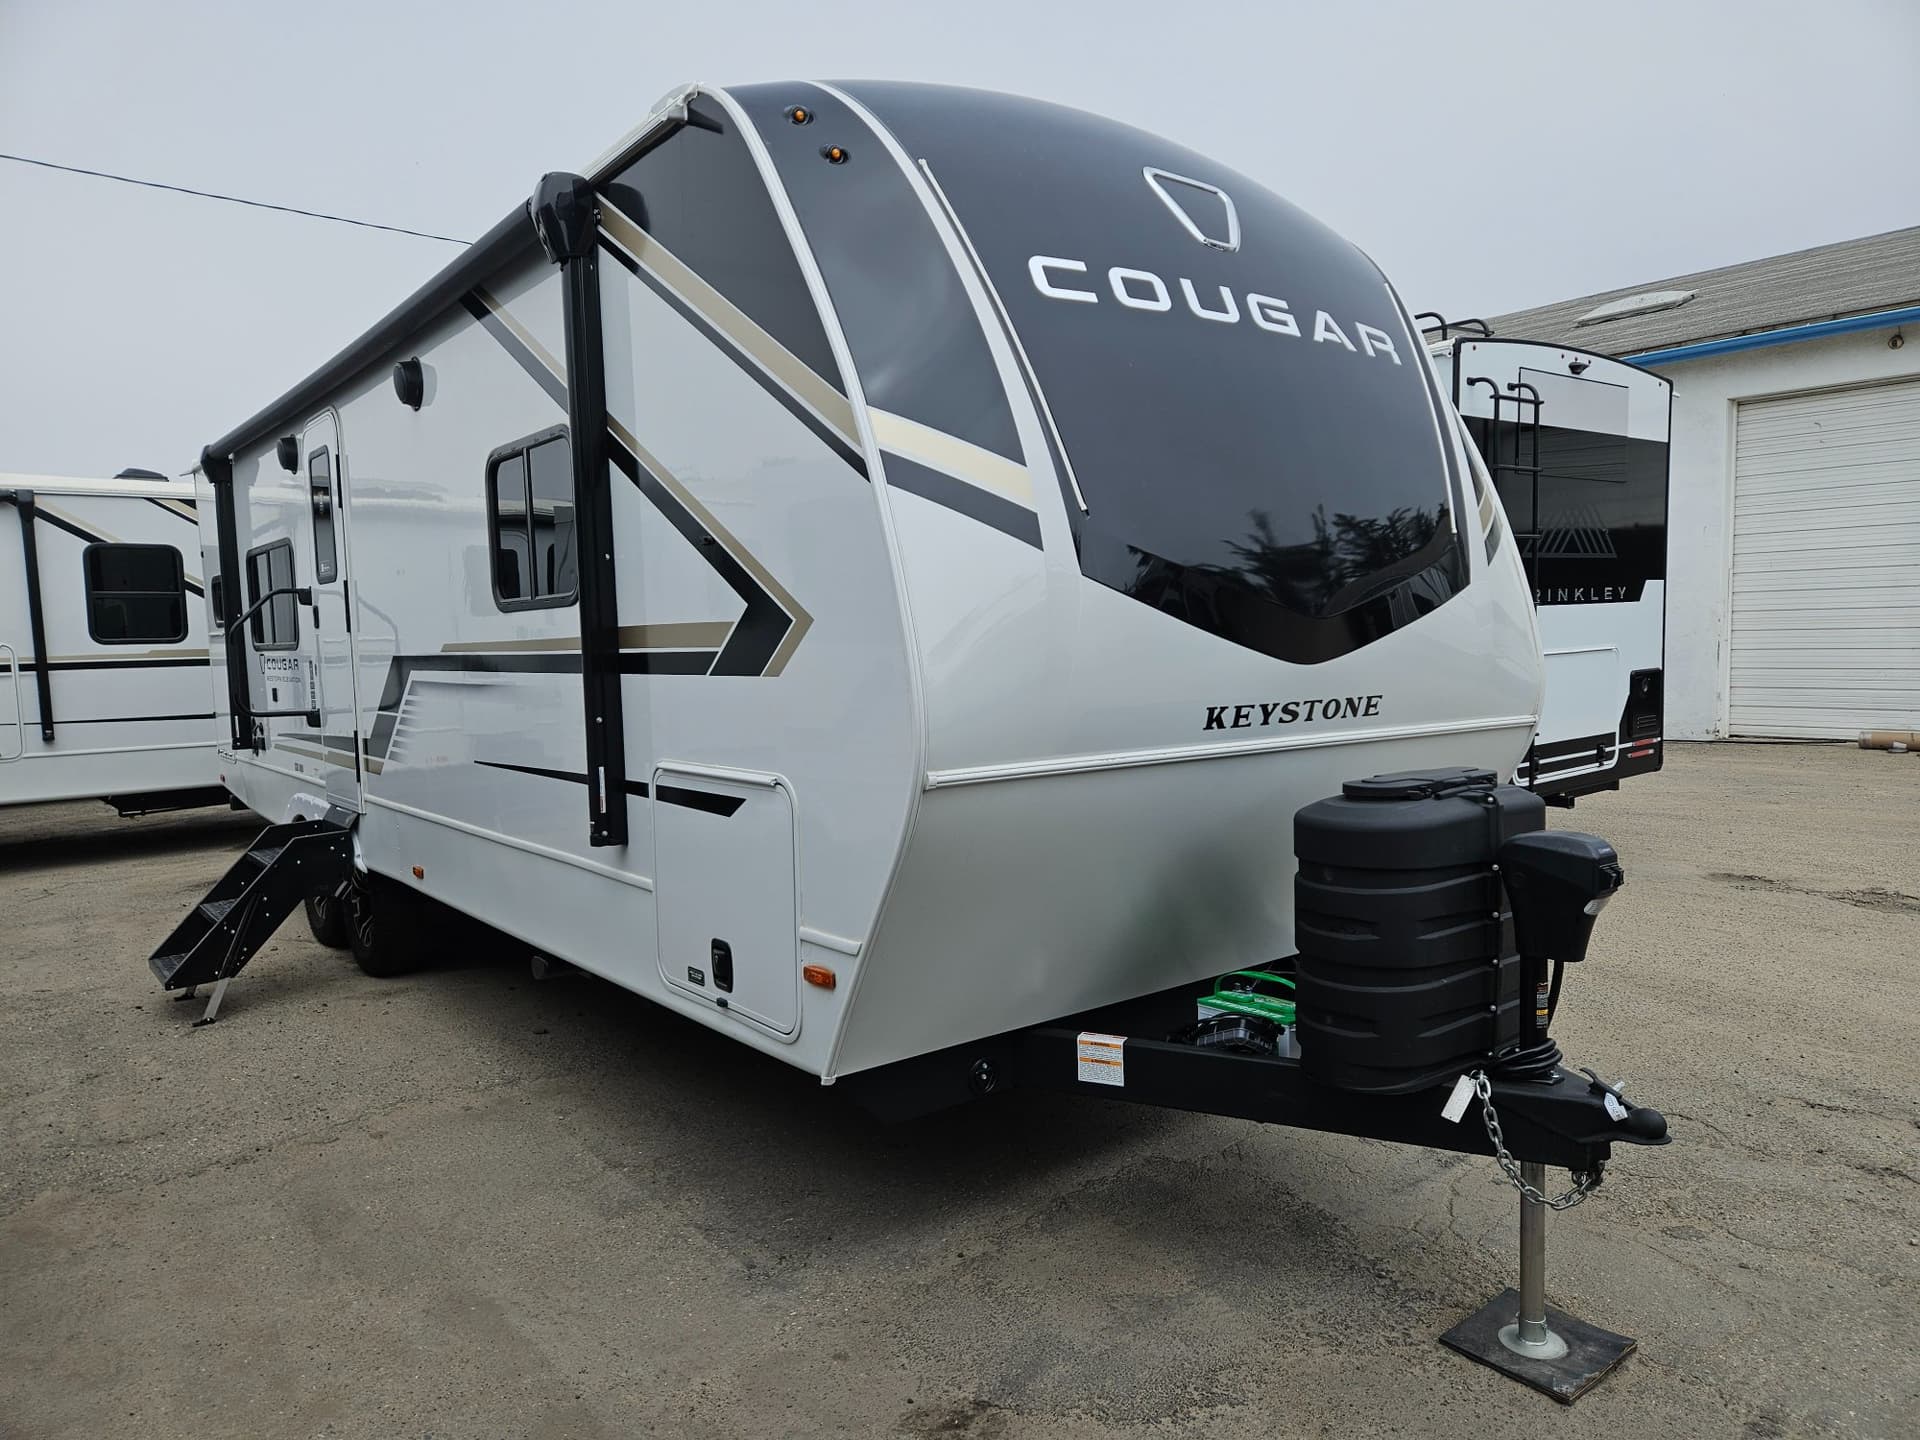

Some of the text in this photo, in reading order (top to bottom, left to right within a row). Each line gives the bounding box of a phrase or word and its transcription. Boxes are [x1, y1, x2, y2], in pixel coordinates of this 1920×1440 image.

[1028, 255, 1402, 366] COUGAR
[266, 658, 299, 670] COUGAR
[1203, 694, 1383, 730] KEYSTONE
